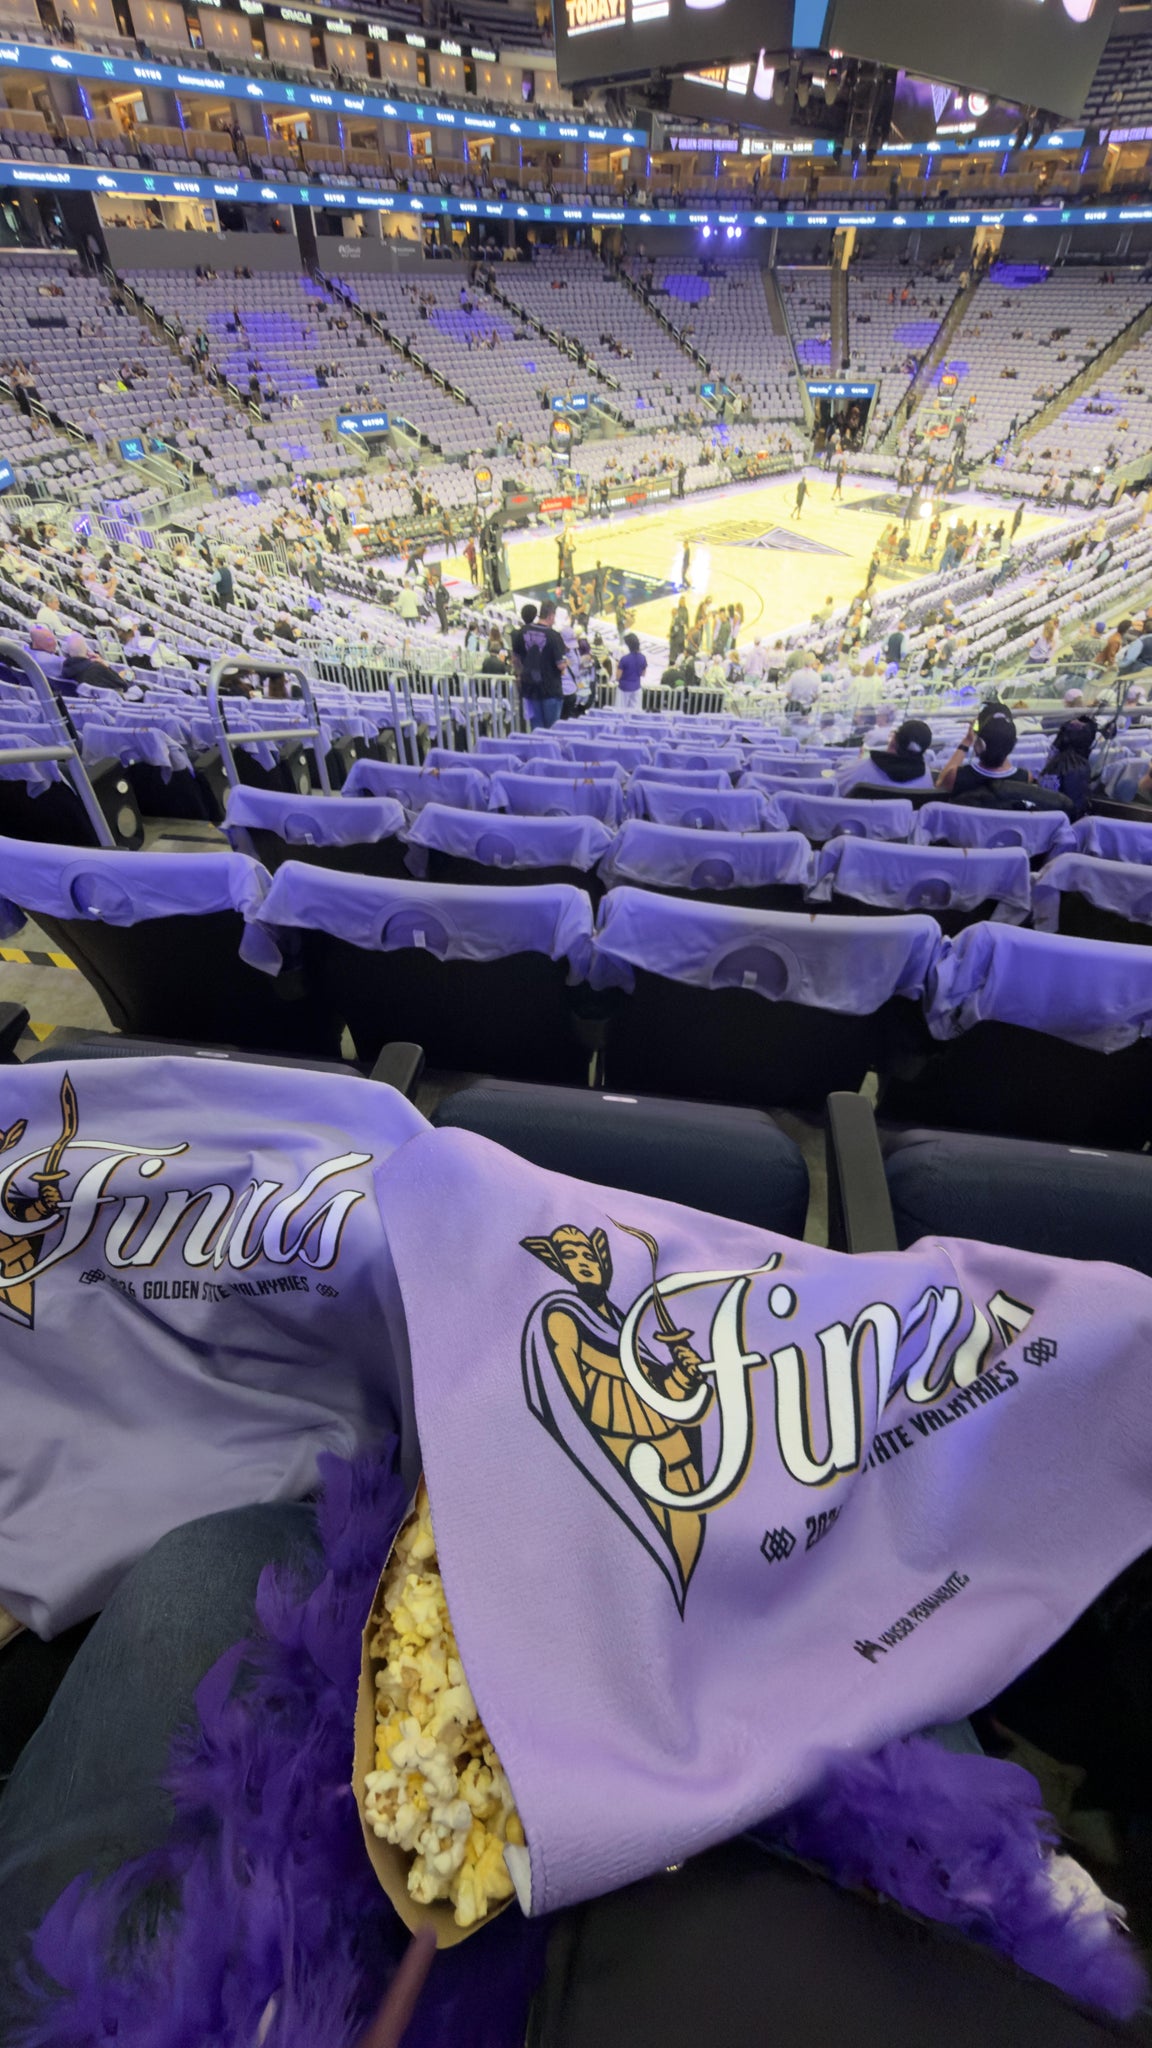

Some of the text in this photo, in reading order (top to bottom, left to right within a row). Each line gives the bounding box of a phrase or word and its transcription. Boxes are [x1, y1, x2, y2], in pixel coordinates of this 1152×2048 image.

[143, 1280, 200, 1300] GOLDEN
[805, 1360, 1020, 1552] 20 ATE VALKYRIES
